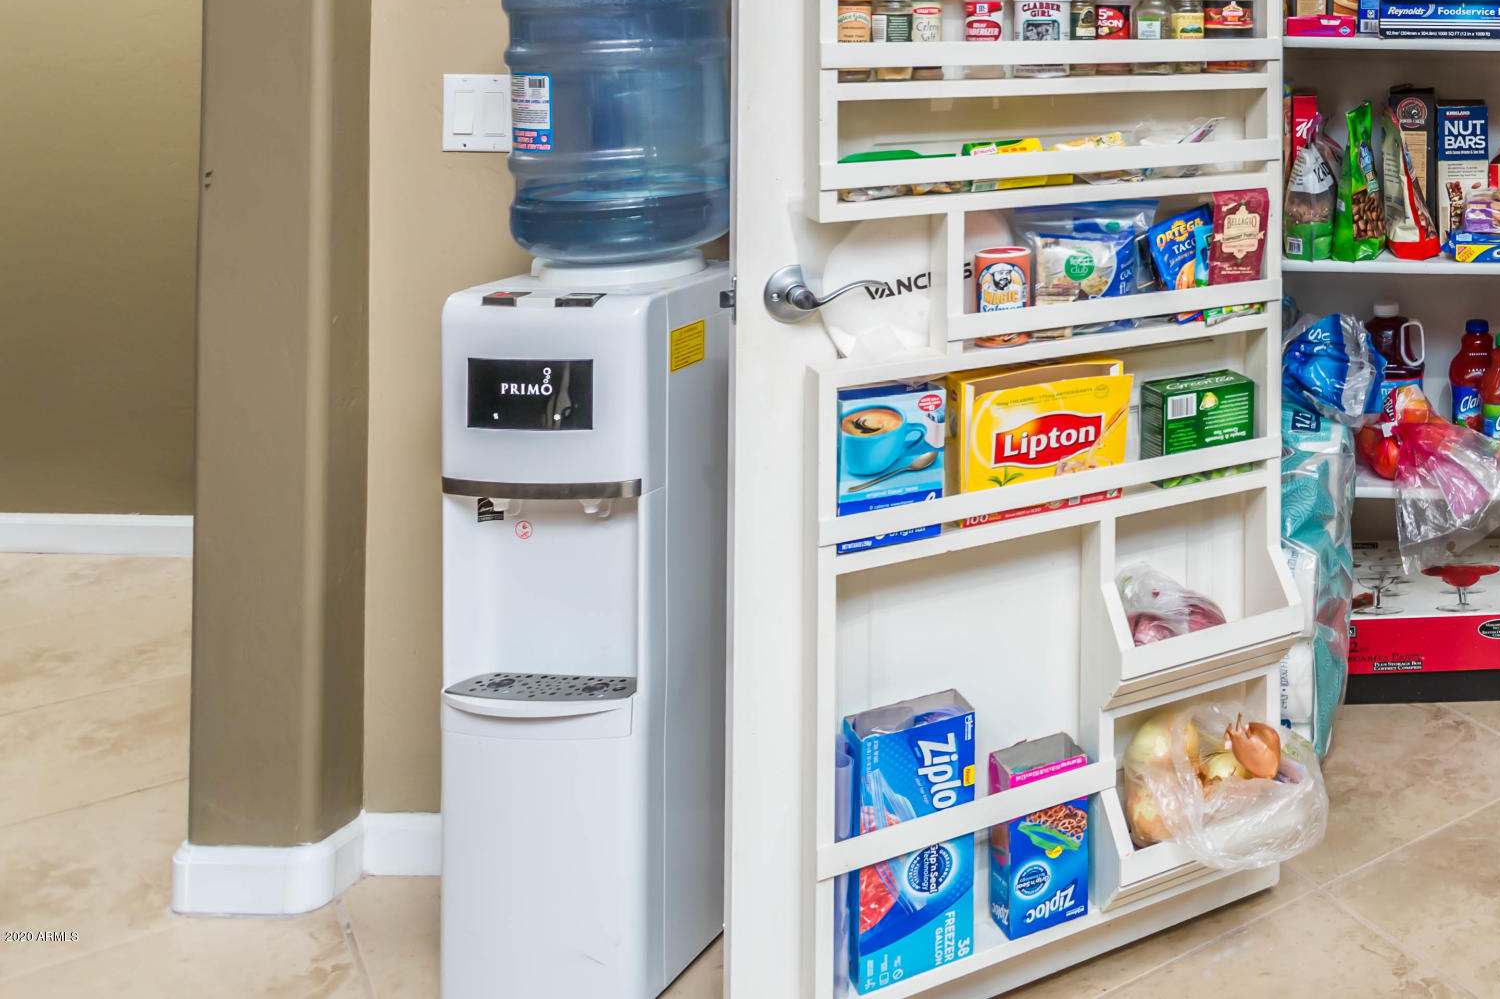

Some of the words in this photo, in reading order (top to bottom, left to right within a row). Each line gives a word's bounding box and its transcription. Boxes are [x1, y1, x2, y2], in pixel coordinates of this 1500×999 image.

[1022, 1, 1060, 12] CLABBER
[1030, 8, 1052, 17] GIRL
[1388, 7, 1425, 16] Reynolds
[1438, 6, 1495, 16] Foodservice
[1098, 19, 1123, 28] ASON
[1444, 120, 1485, 135] NUT
[1444, 136, 1486, 149] BARS
[1227, 216, 1256, 229] BELLAGIO
[1157, 218, 1203, 248] ORTEGA
[1071, 265, 1088, 274] club
[983, 290, 1018, 305] MAGIC
[501, 383, 553, 395] PRIMO
[1003, 426, 1096, 459] Lipton
[917, 733, 961, 809] Ziplo
[1025, 884, 1075, 924] Ziploc
[991, 904, 1009, 926] Ziploc
[945, 911, 955, 962] FREEZER
[935, 928, 943, 966] GALLON
[958, 937, 970, 957] 38
